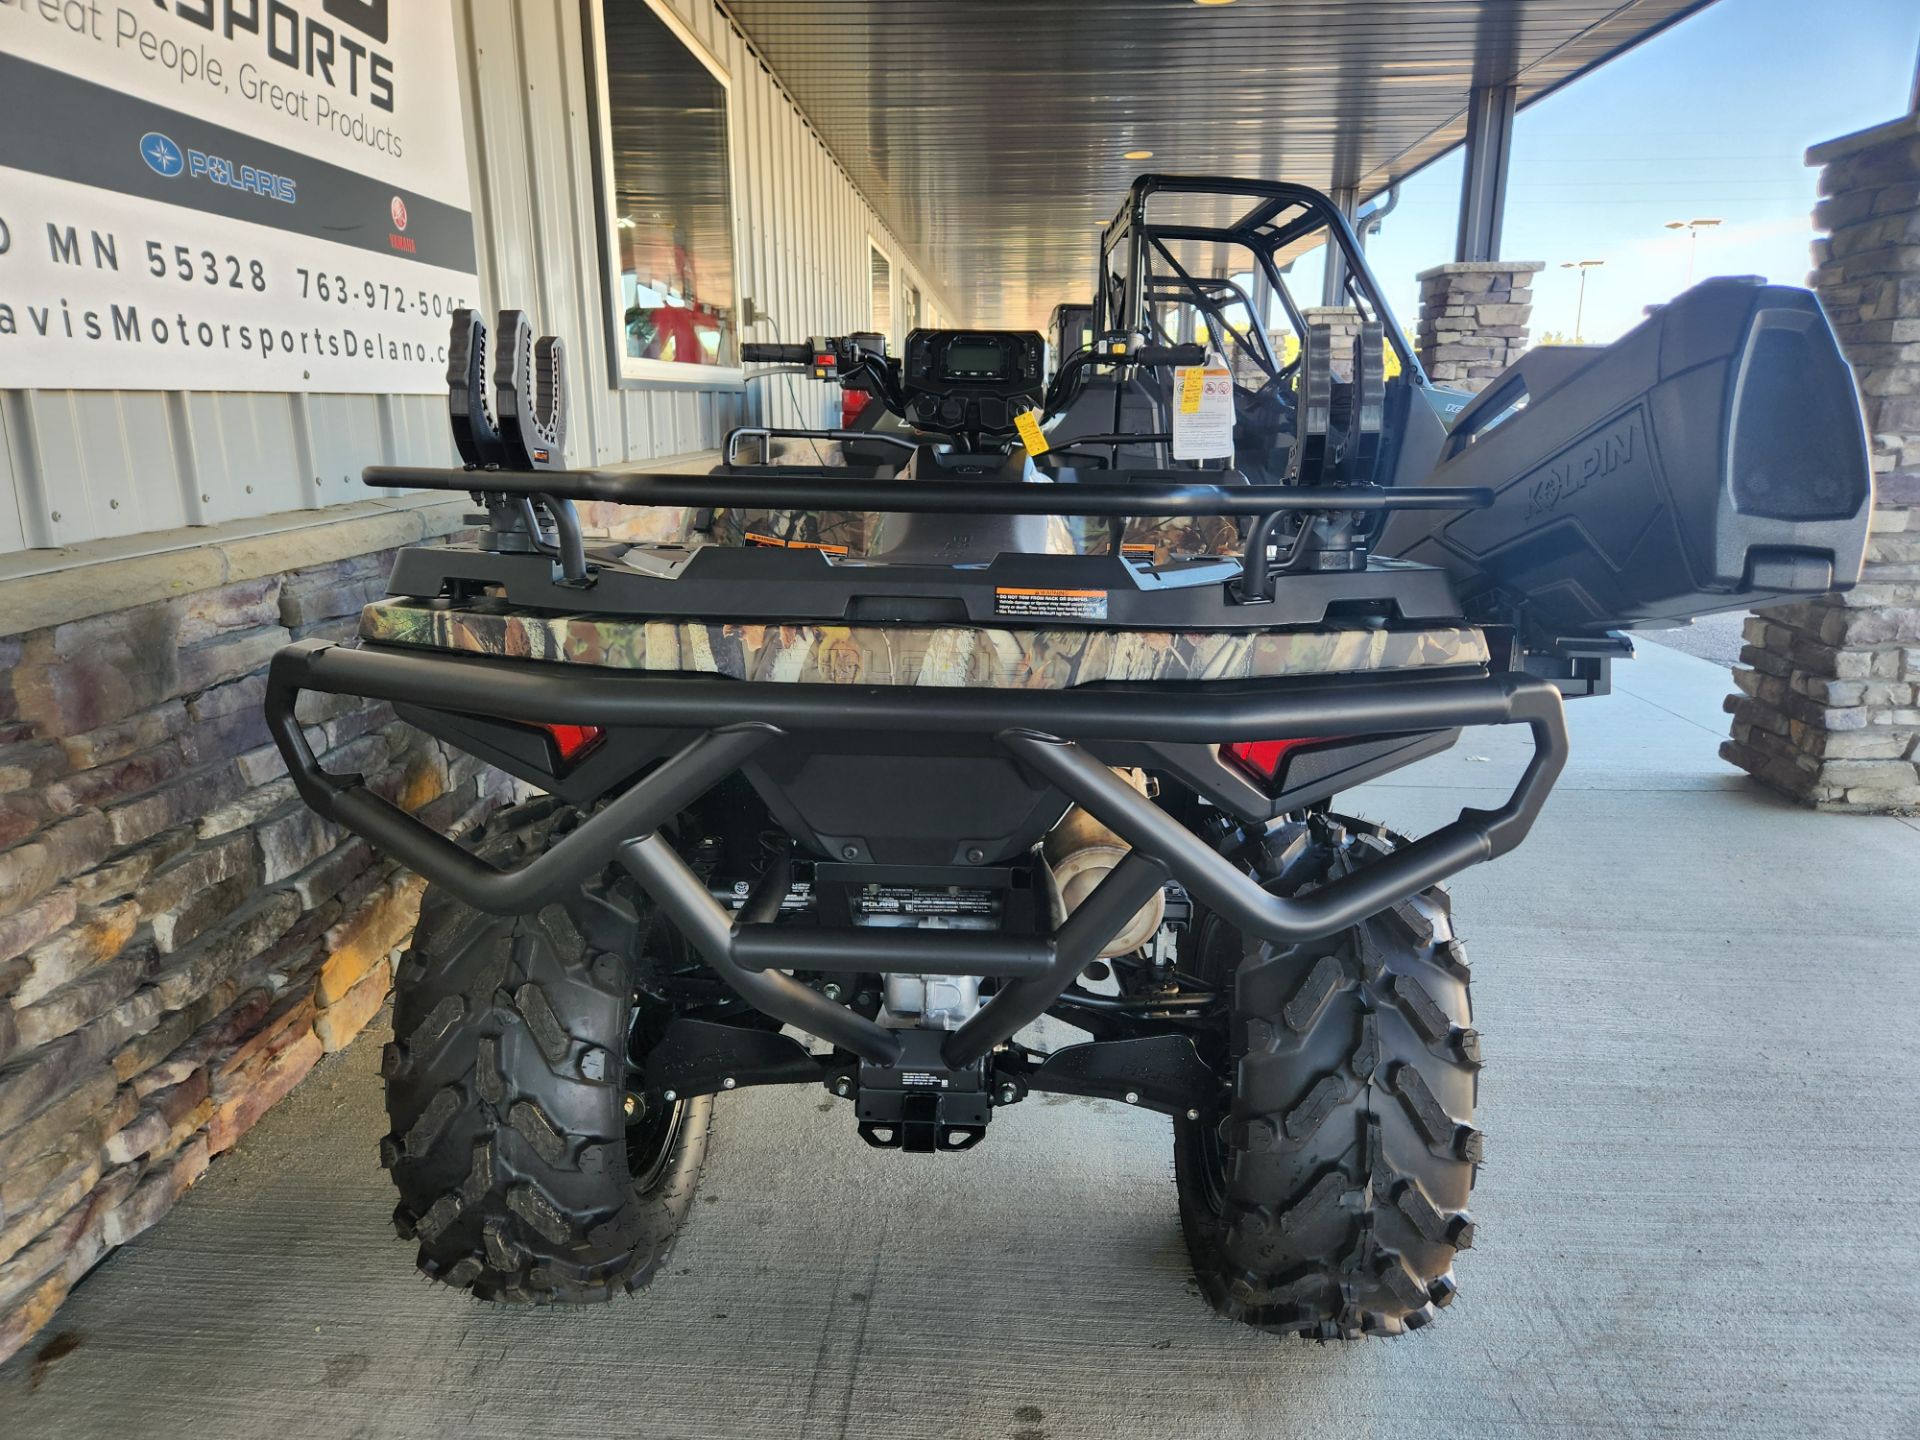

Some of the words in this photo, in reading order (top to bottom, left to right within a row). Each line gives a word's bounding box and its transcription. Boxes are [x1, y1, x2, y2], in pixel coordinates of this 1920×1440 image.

[0, 0, 102, 41] eat
[116, 7, 229, 94] People,
[239, 62, 309, 121] Great
[316, 94, 403, 158] Products
[154, 0, 394, 114] PORTS
[187, 148, 297, 204] POLARIS
[46, 222, 119, 271] MN
[145, 240, 267, 292] 55328
[388, 233, 417, 254] YAMAHA
[1525, 424, 1635, 520] KOLPIN
